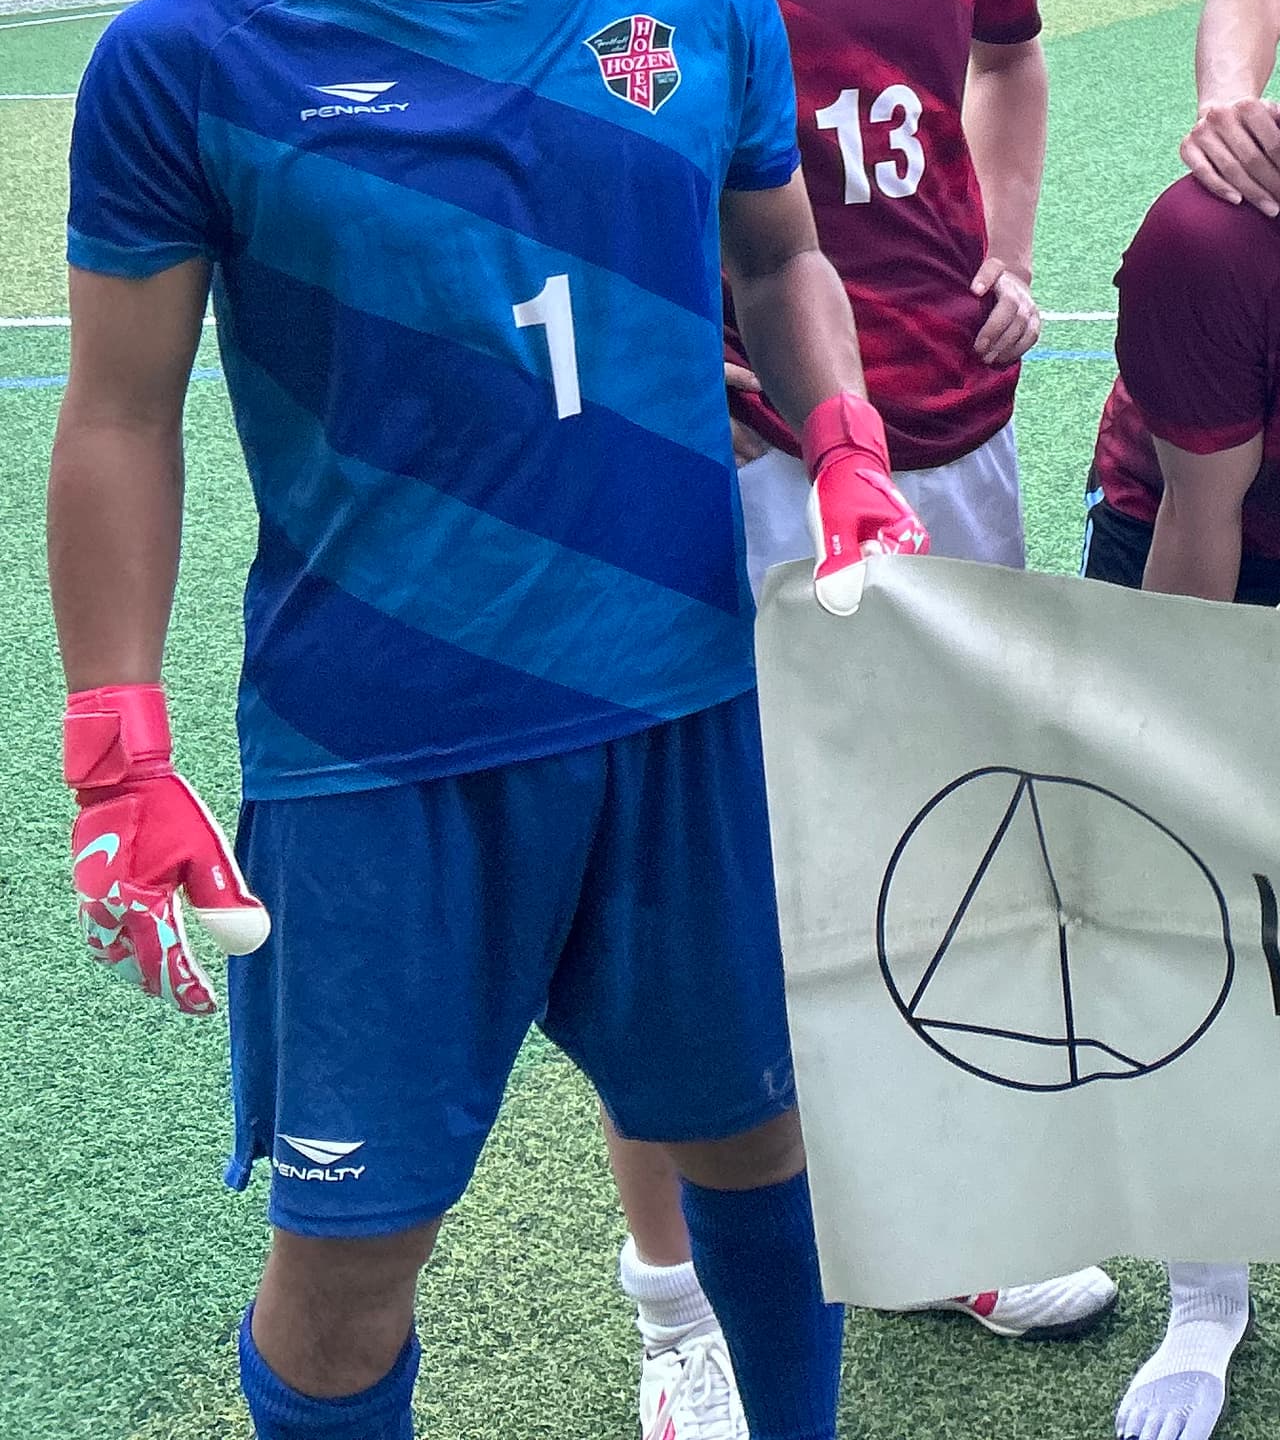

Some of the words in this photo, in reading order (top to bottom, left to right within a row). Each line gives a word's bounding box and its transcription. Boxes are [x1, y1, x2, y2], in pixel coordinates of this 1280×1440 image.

[606, 53, 672, 77] HOZEN
[300, 103, 410, 121] PENALTY
[815, 84, 926, 205] 13
[513, 275, 581, 420] 1
